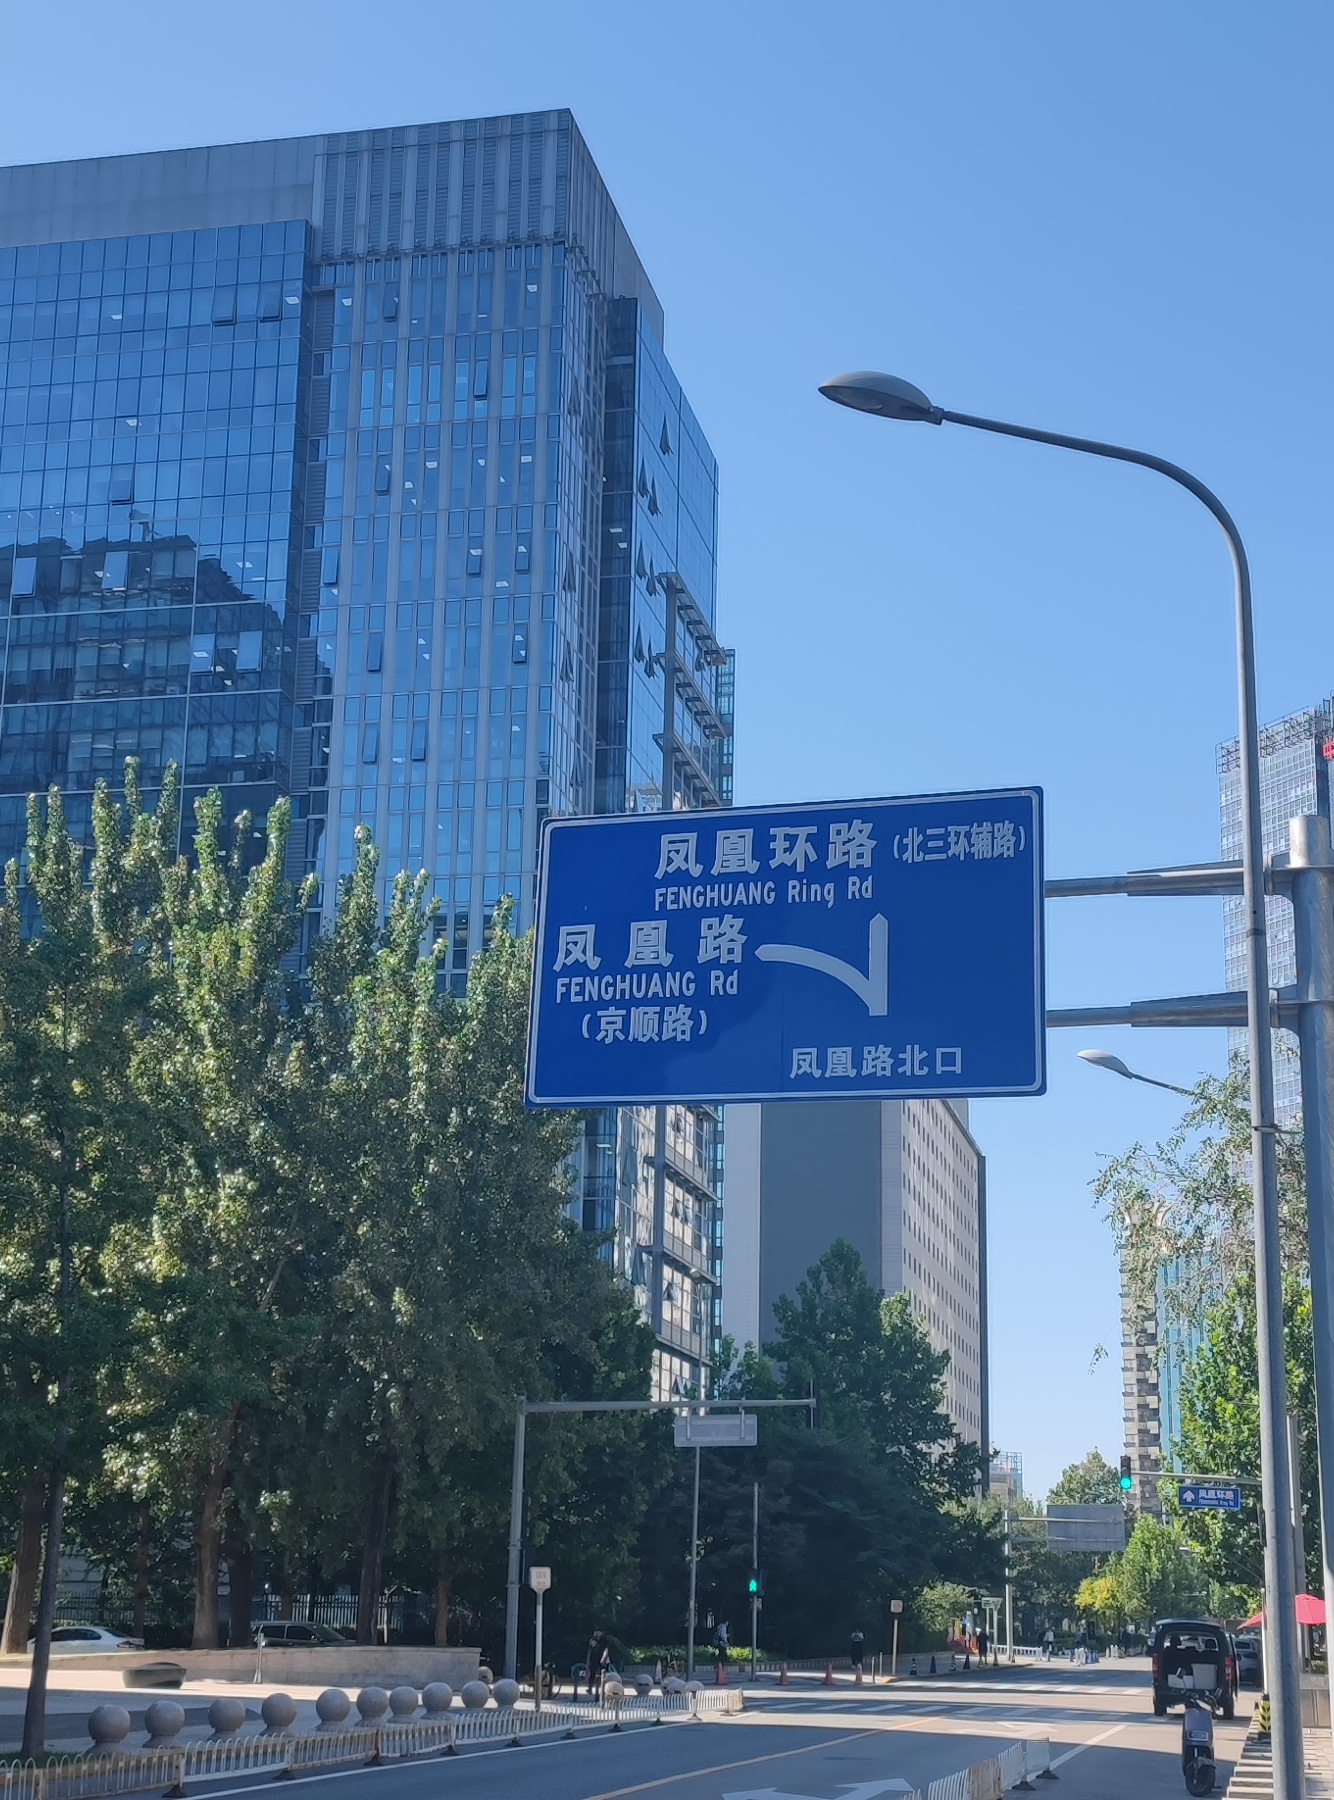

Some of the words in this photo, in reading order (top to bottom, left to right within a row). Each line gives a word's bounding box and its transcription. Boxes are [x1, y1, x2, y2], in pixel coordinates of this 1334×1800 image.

[653, 818, 878, 881] 凤凰环路
[892, 818, 1027, 864] (北三环辅路)
[654, 880, 776, 912] FENGHUANG
[787, 878, 835, 909] Ring
[847, 875, 874, 900] Rd
[553, 914, 748, 972] 凤凰路
[555, 971, 697, 1004] FENGHUANG
[709, 969, 739, 997] Rd
[581, 1005, 708, 1045] (京顺路)
[789, 1043, 964, 1079] 凤凰路北口
